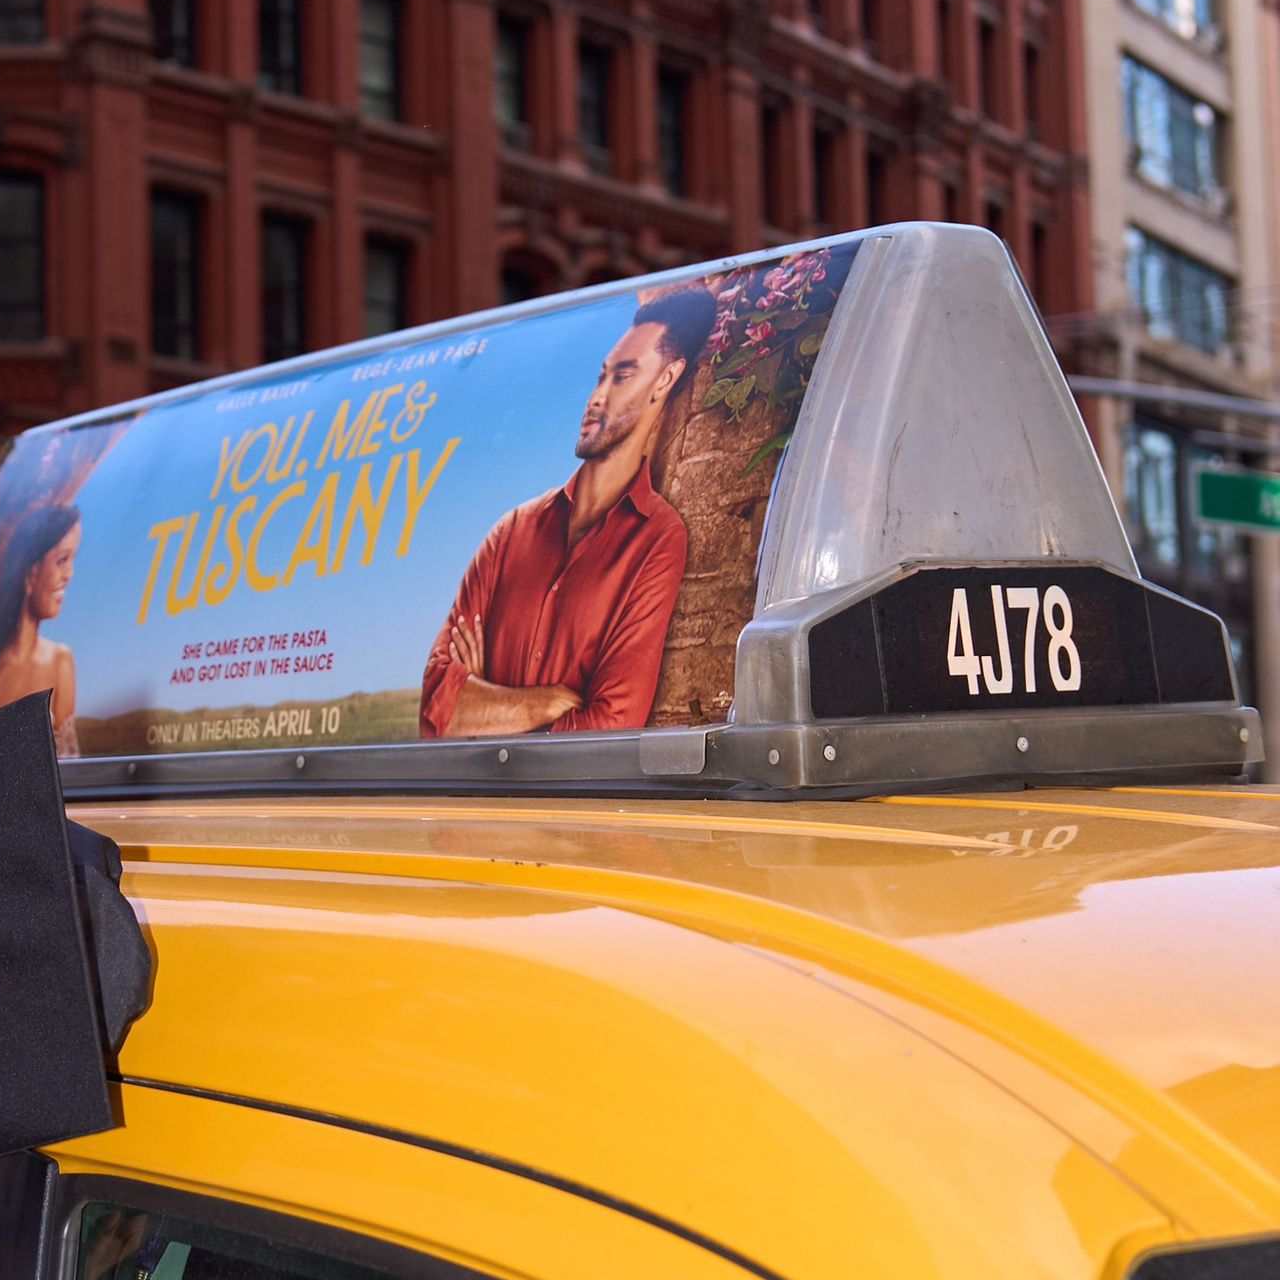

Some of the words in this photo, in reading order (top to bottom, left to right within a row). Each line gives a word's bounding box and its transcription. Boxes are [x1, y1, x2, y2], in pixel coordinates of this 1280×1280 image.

[443, 338, 489, 362] PAGE
[216, 390, 256, 412] HALLE
[260, 380, 311, 404] BAILEY
[209, 409, 315, 499] YOU,
[135, 436, 463, 624] TUSCANY
[181, 642, 203, 660] SHE
[205, 637, 239, 658] CAME
[241, 635, 266, 653] FOR
[268, 632, 290, 651] THE
[291, 629, 327, 648] PASTA
[946, 584, 1082, 696] 4J78
[169, 668, 195, 684] AND
[197, 664, 223, 682] GOT
[224, 661, 252, 679] LOST
[253, 659, 268, 676] IN
[270, 656, 292, 674] THE
[293, 653, 334, 673] SAUCE
[146, 724, 182, 745] ONLY
[182, 722, 198, 742] IN
[200, 717, 261, 741] THEATERS
[263, 708, 313, 737] APRIL
[320, 705, 340, 735] 10
